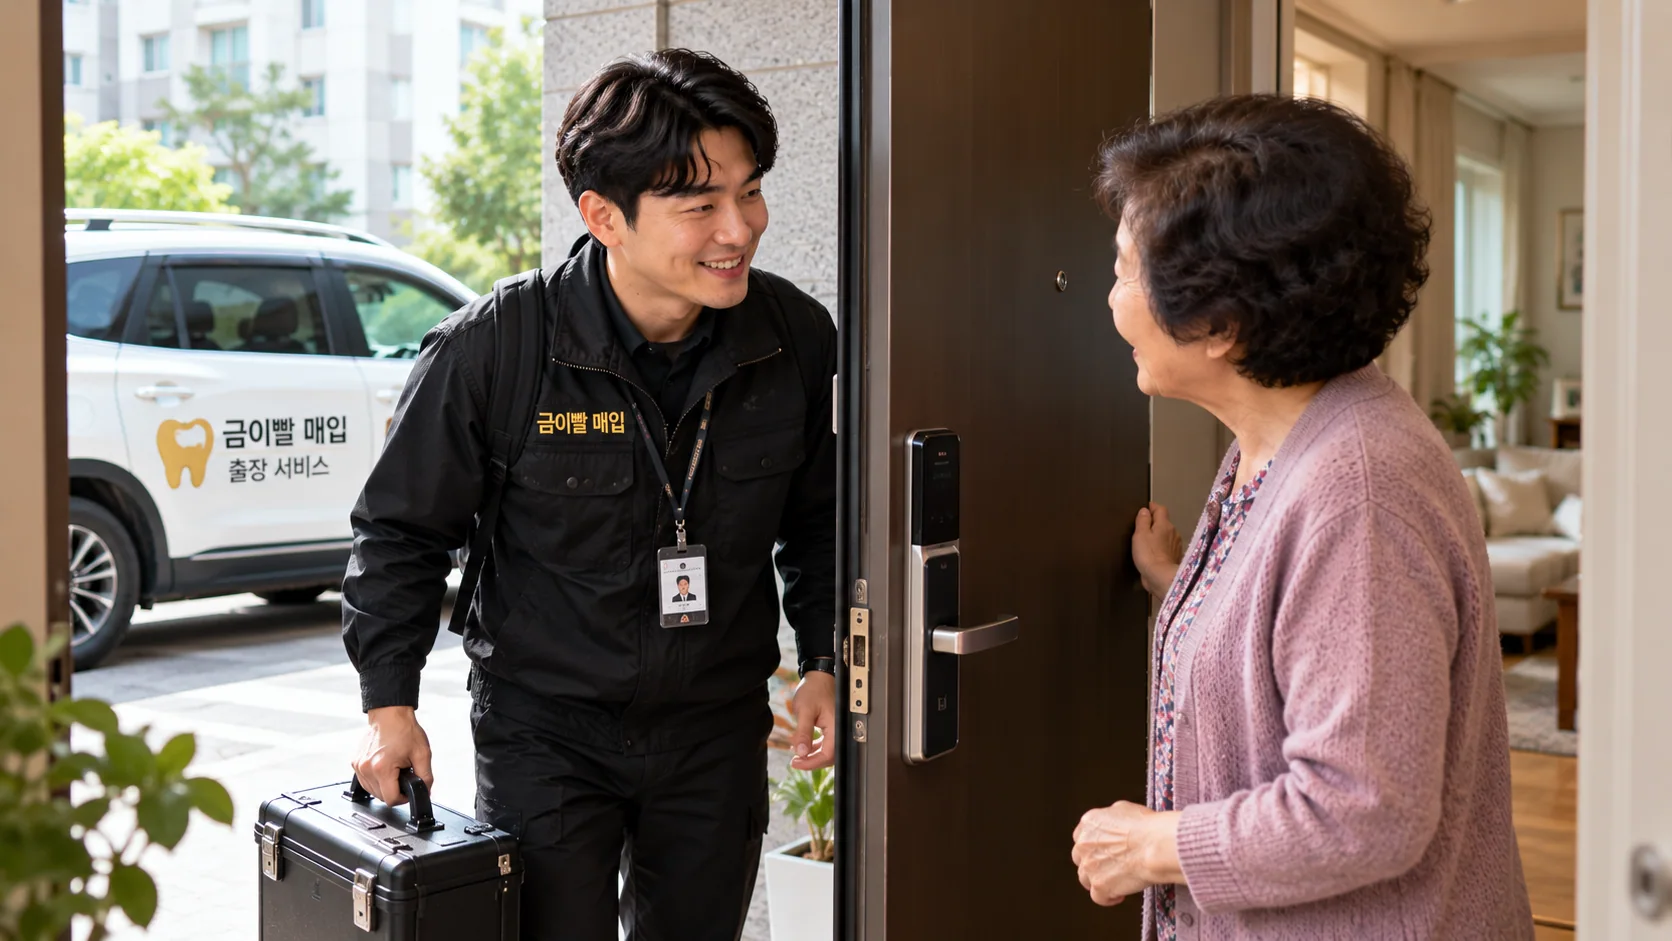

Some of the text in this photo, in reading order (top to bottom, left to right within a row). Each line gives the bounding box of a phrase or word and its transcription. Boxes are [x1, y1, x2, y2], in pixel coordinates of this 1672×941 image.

[223, 416, 346, 448] 금이빨 매입
[536, 412, 588, 435] 금이빨
[592, 411, 625, 434] 매입
[229, 455, 330, 483] 출장 서비스
